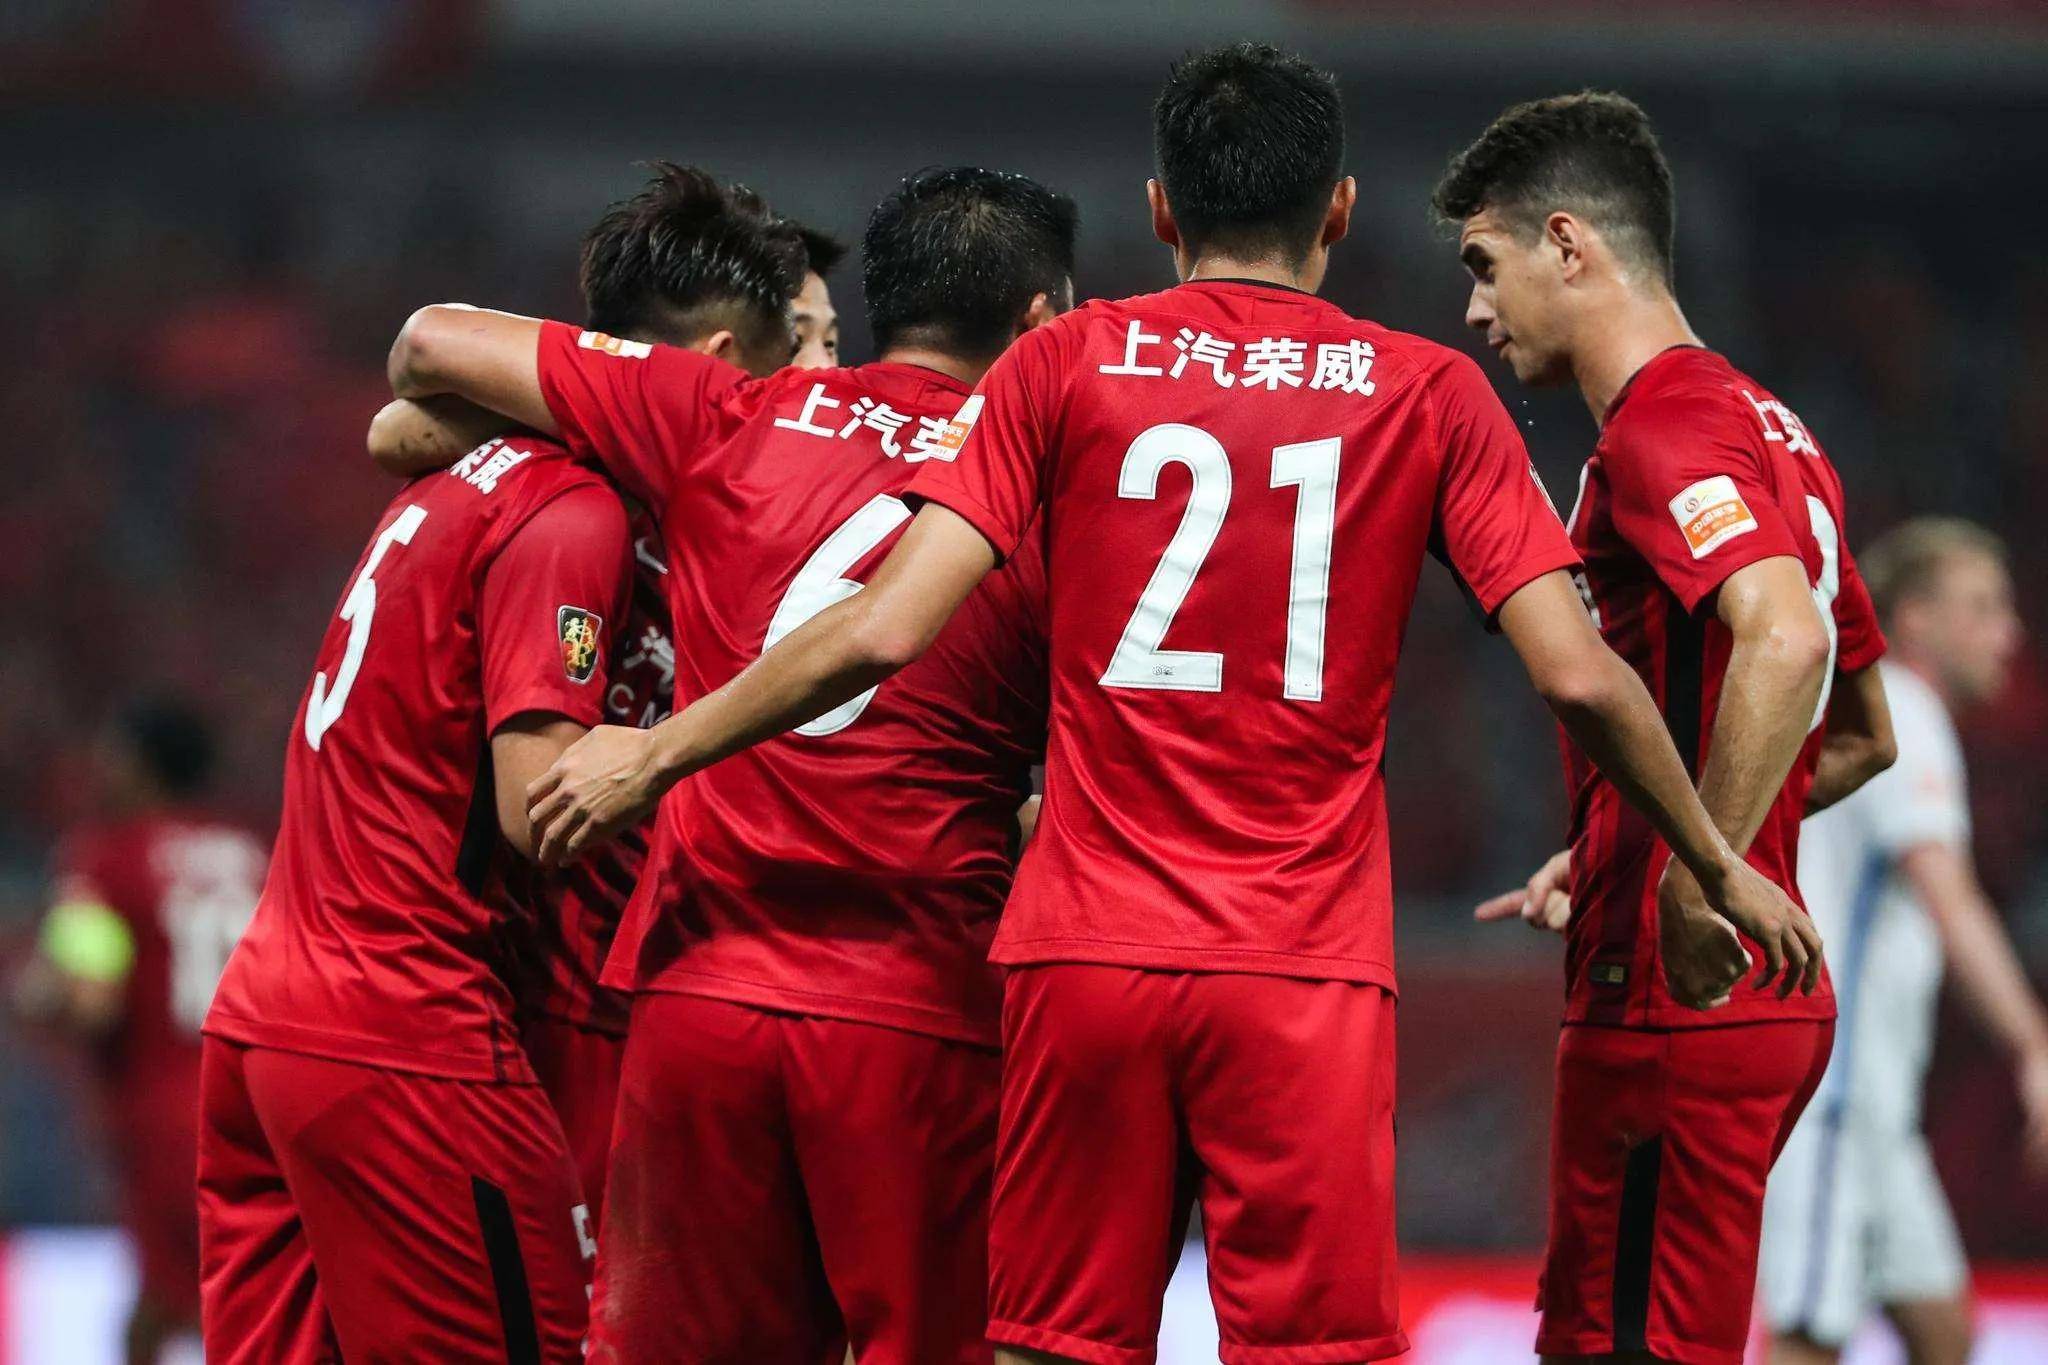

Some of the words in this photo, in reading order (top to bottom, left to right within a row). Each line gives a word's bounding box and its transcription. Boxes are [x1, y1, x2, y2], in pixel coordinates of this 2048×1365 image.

[1098, 319, 1376, 397] 上汽荣威
[1100, 423, 1342, 702] 21
